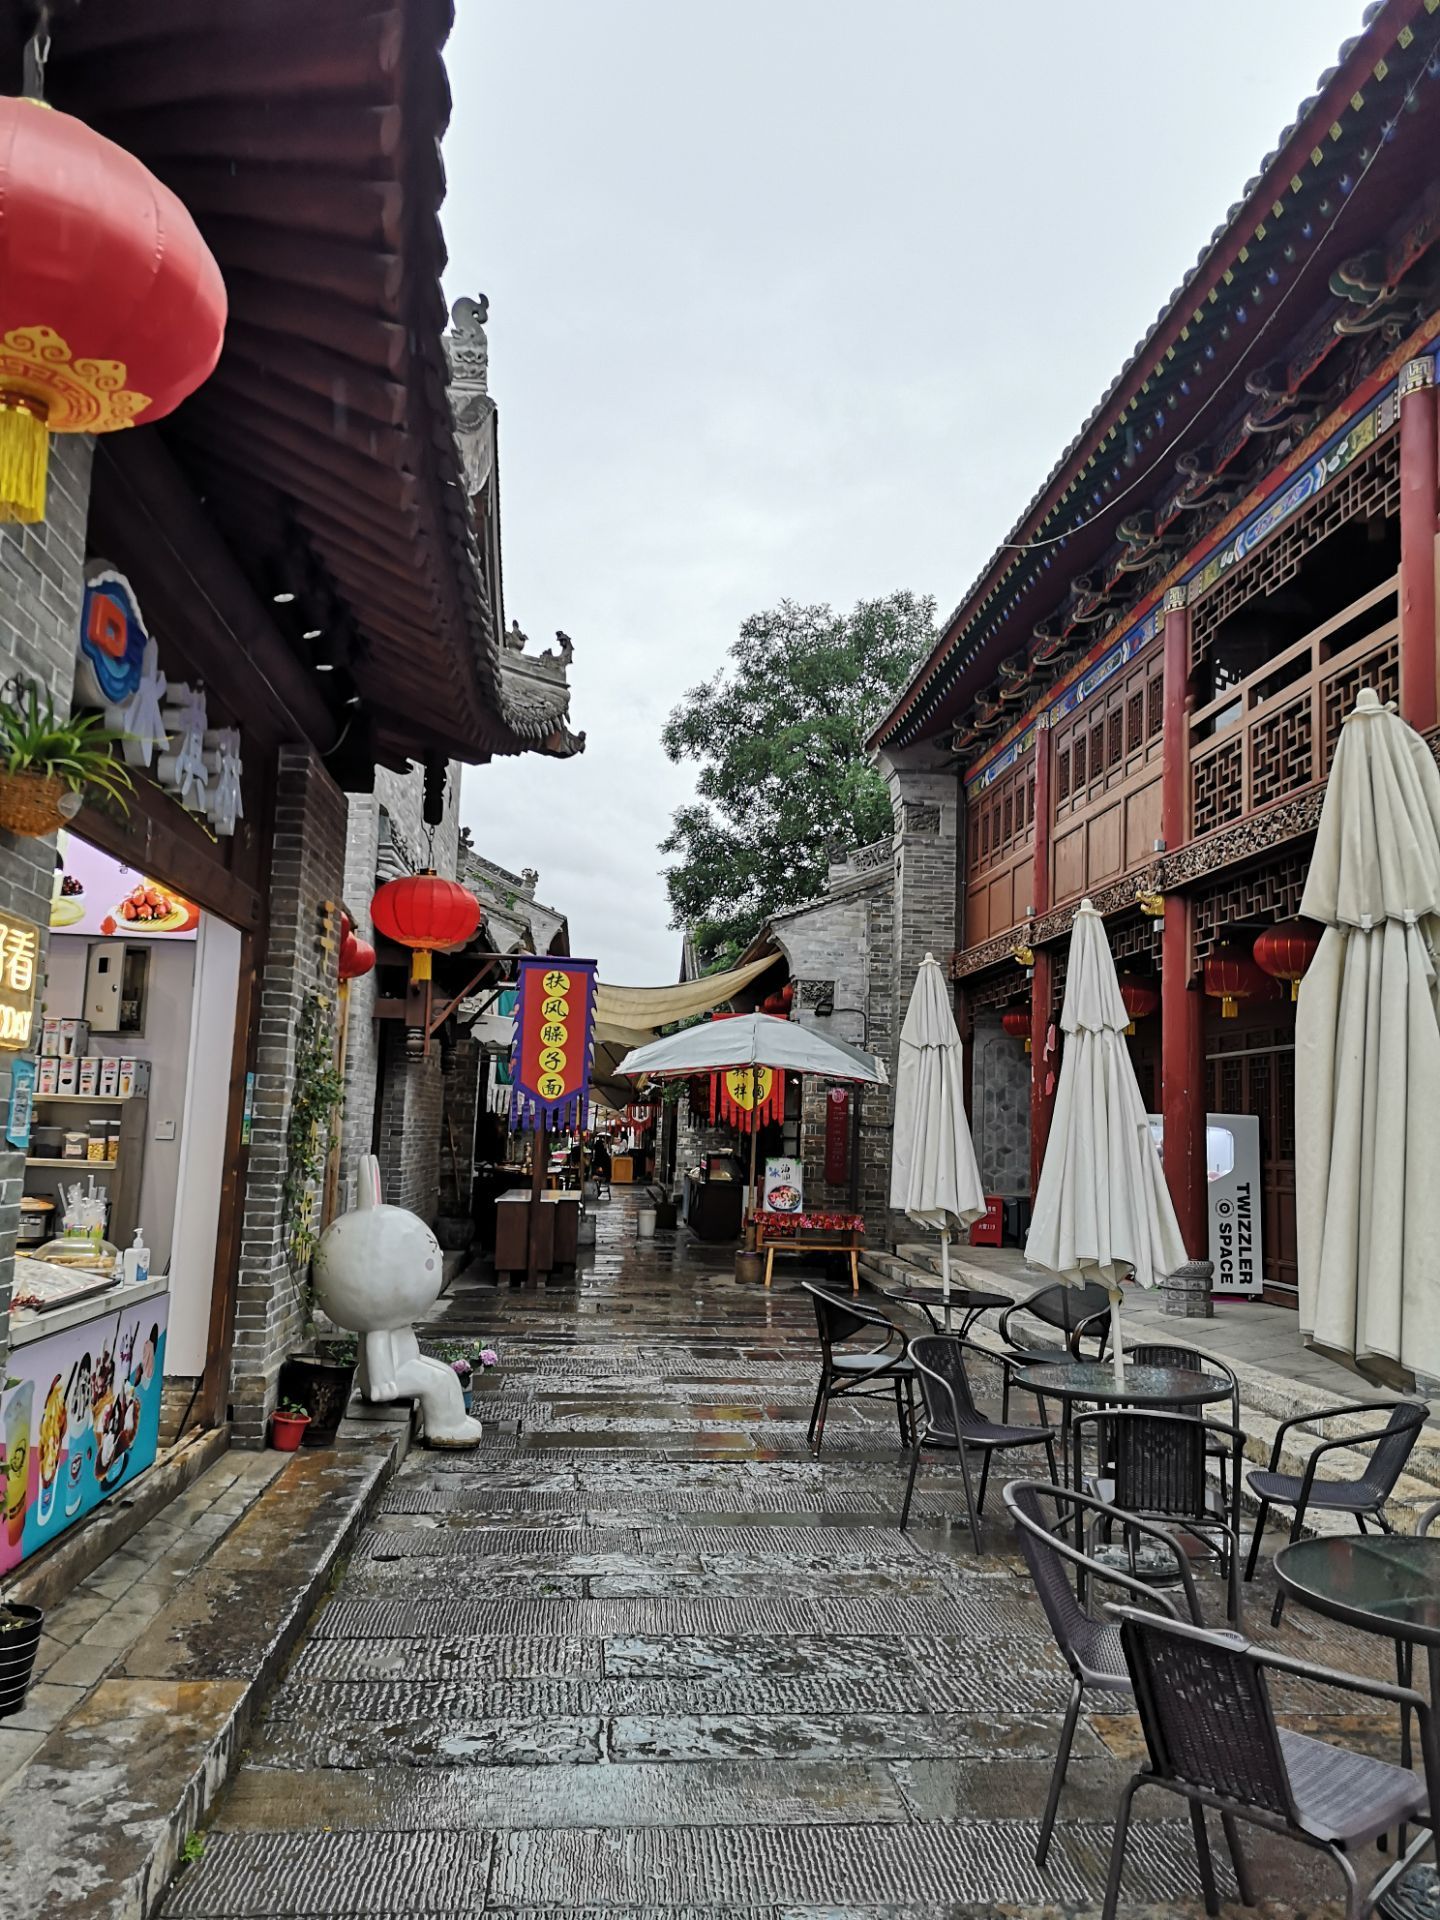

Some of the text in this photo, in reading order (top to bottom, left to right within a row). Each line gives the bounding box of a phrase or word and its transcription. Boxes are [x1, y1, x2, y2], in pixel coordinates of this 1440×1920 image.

[541, 972, 569, 1097] 扶风臊子面
[1218, 1222, 1234, 1285] SPACE
[1236, 1182, 1253, 1285] TWIZZLER
